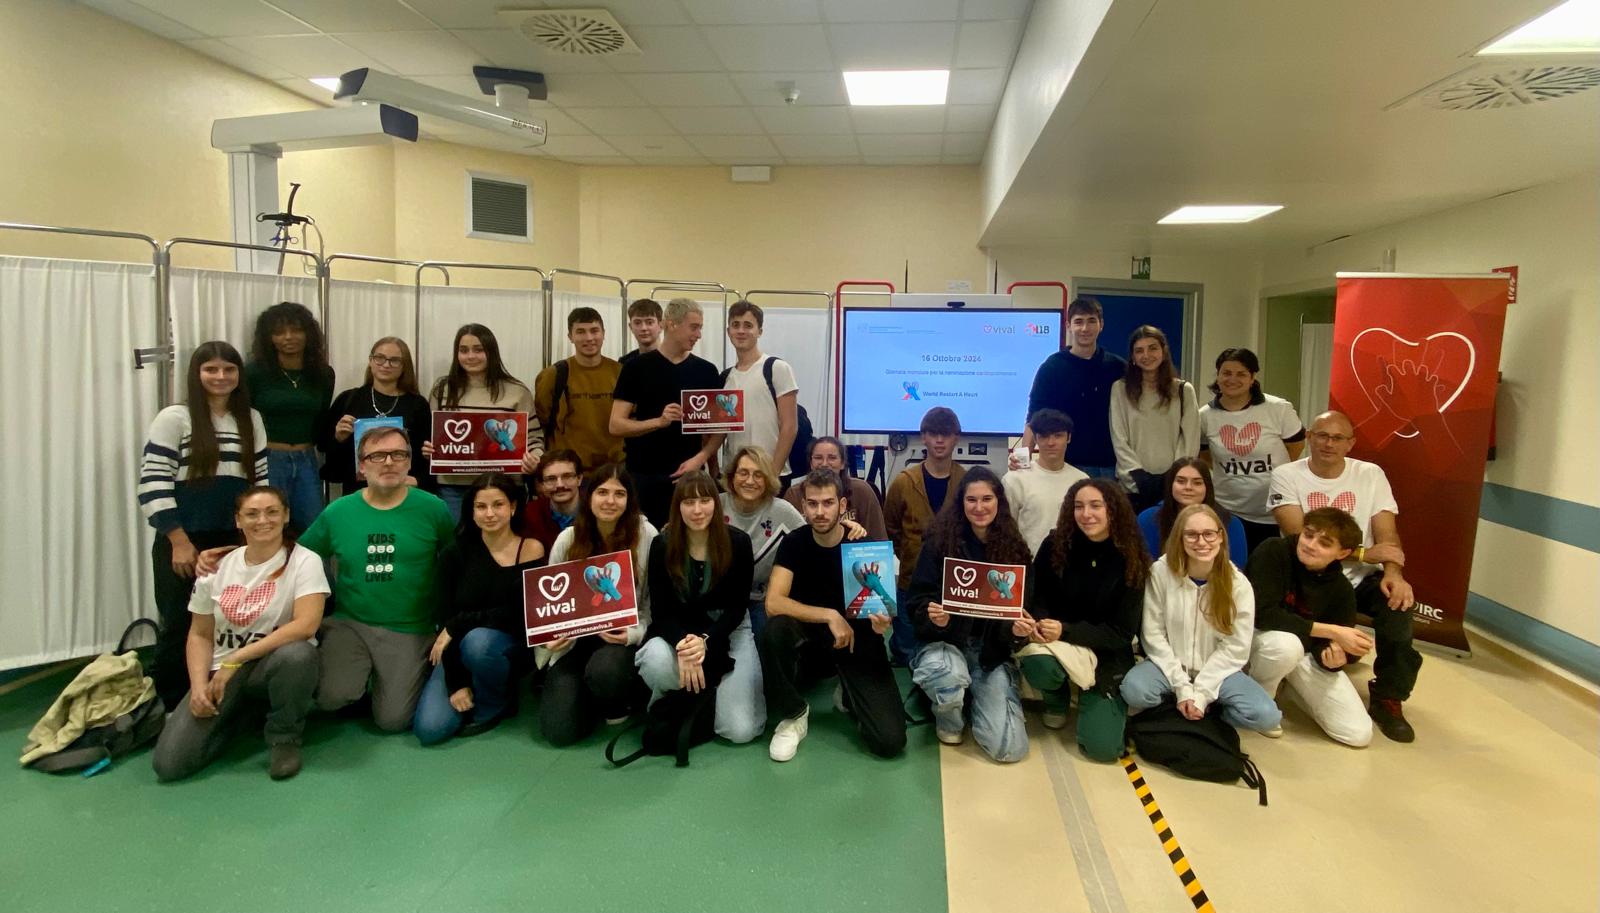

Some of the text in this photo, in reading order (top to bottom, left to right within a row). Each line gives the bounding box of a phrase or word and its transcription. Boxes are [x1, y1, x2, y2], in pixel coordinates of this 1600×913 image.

[921, 355, 931, 363] 16
[687, 410, 711, 420] viva!
[440, 442, 475, 455] viva!
[1218, 453, 1273, 476] viva!
[367, 533, 396, 544] KIDS
[367, 553, 395, 563] SAVE
[365, 573, 394, 582] LIVES
[950, 585, 979, 599] viva!
[535, 597, 576, 619] viva!
[216, 624, 278, 649] viva
[552, 622, 613, 639] www.settimanaviva.it
